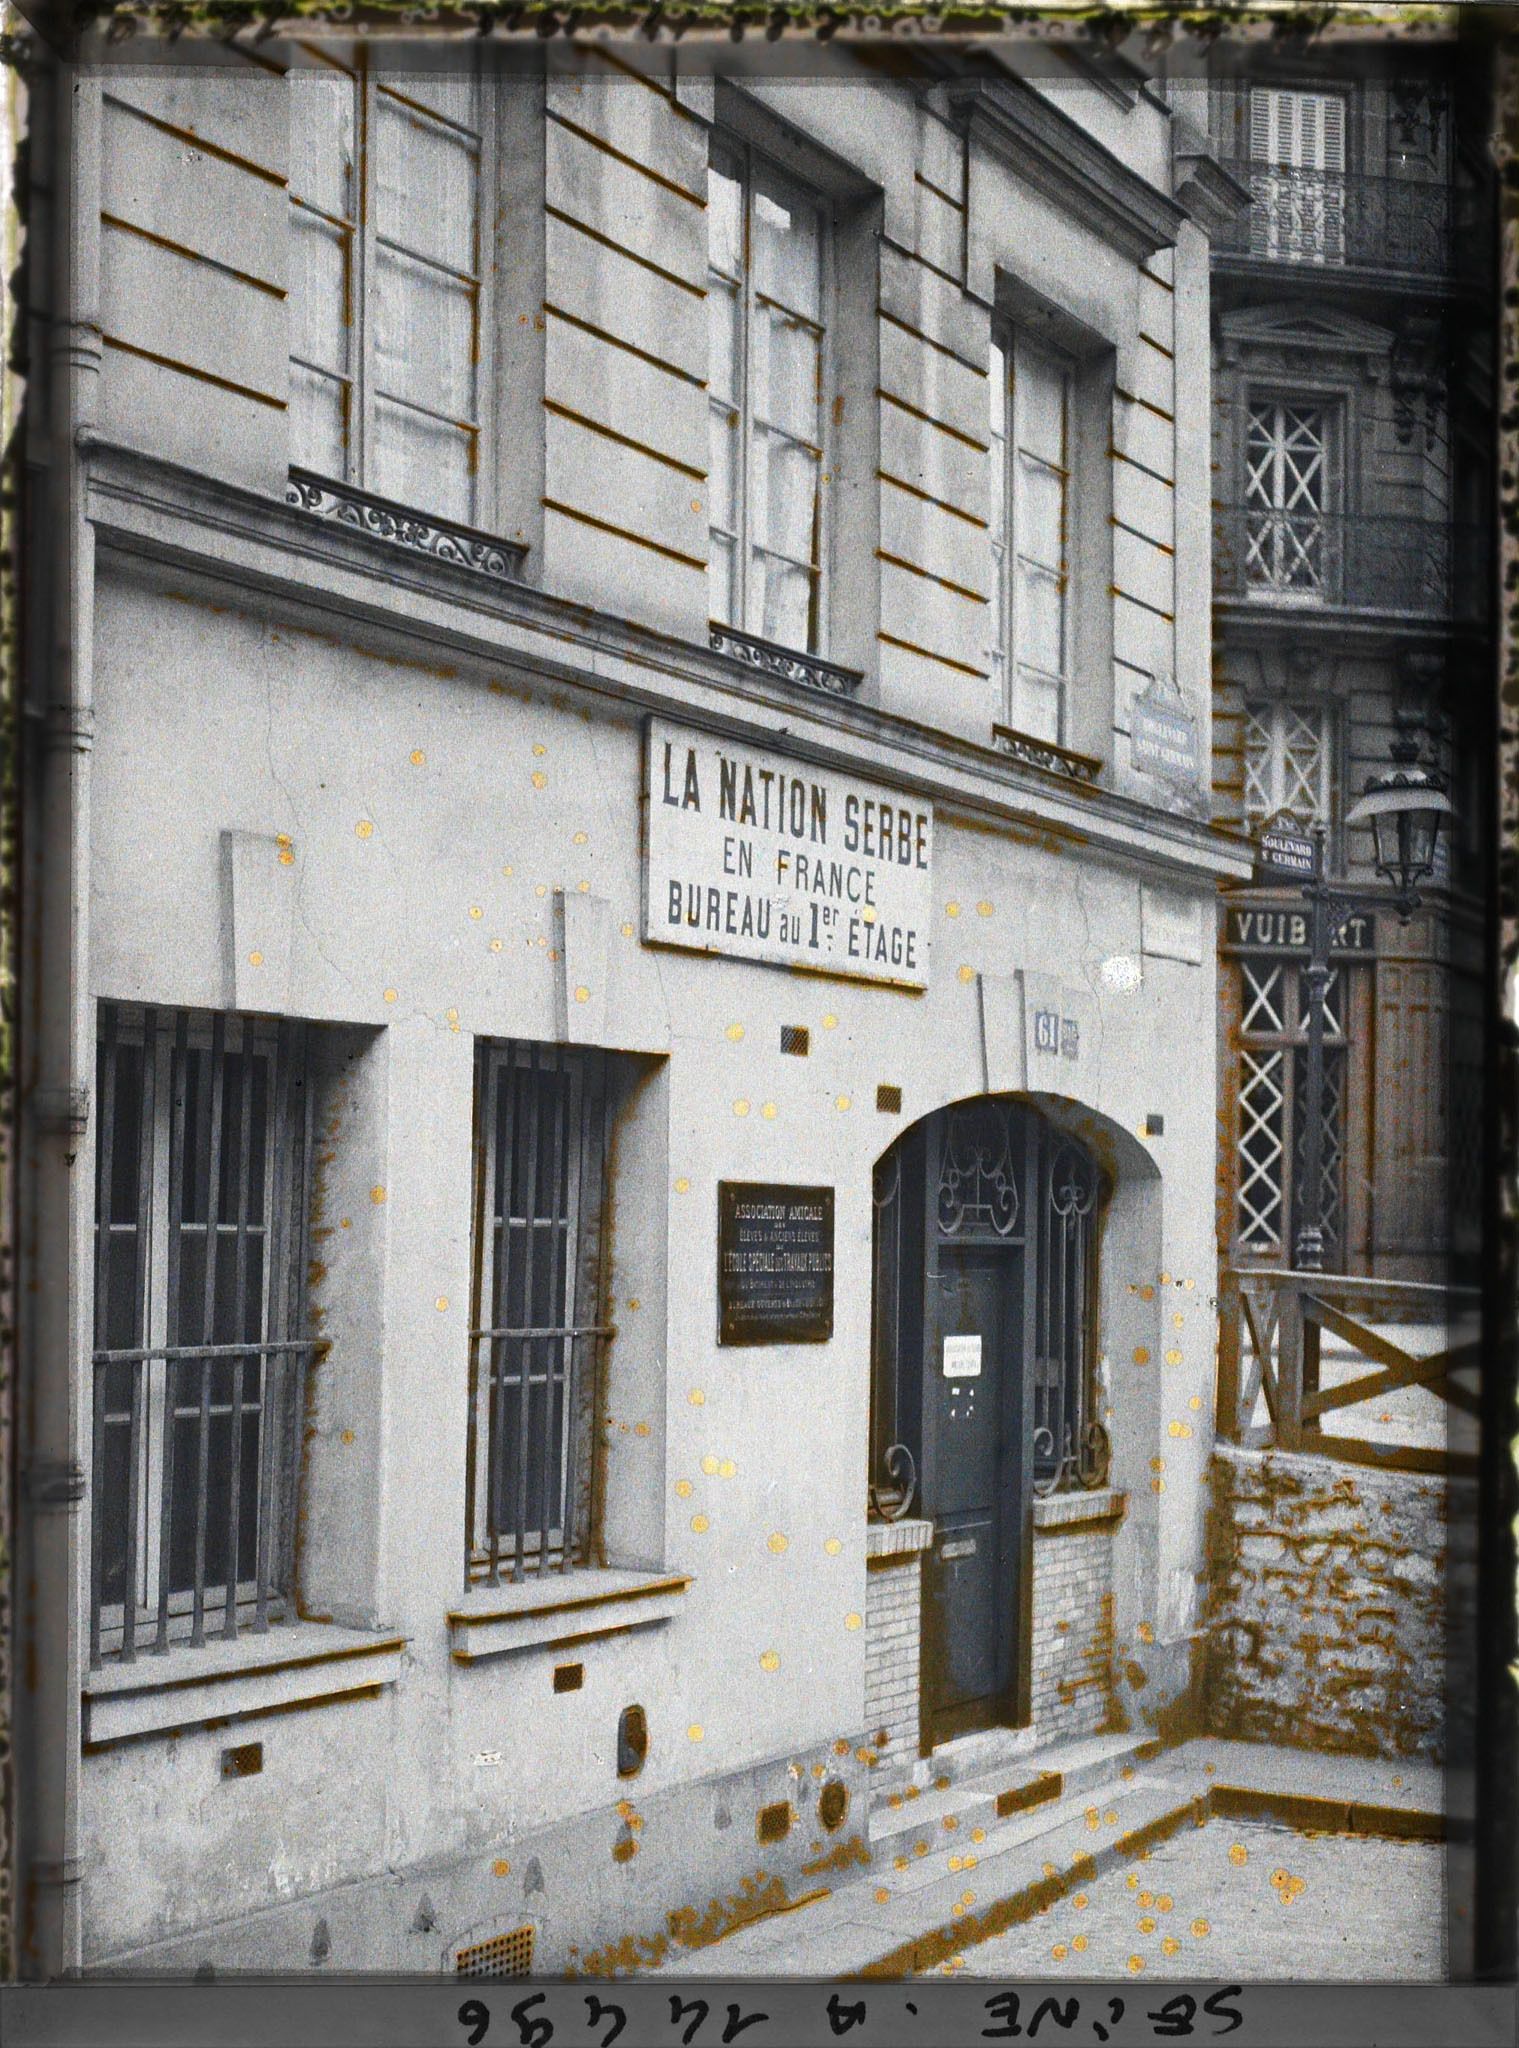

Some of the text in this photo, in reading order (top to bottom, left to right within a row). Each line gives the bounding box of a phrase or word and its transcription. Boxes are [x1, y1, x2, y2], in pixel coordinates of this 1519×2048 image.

[662, 742, 928, 870] LA NATION SERBE
[723, 836, 875, 907] EN FRANCE
[1272, 852, 1312, 870] GERMAIN
[668, 880, 771, 939] BUREAU
[780, 913, 800, 945] au
[1237, 912, 1367, 948] VUIBRT
[1038, 1015, 1056, 1047] 61
[735, 1204, 823, 1221] ASSOCIATION AMICALE
